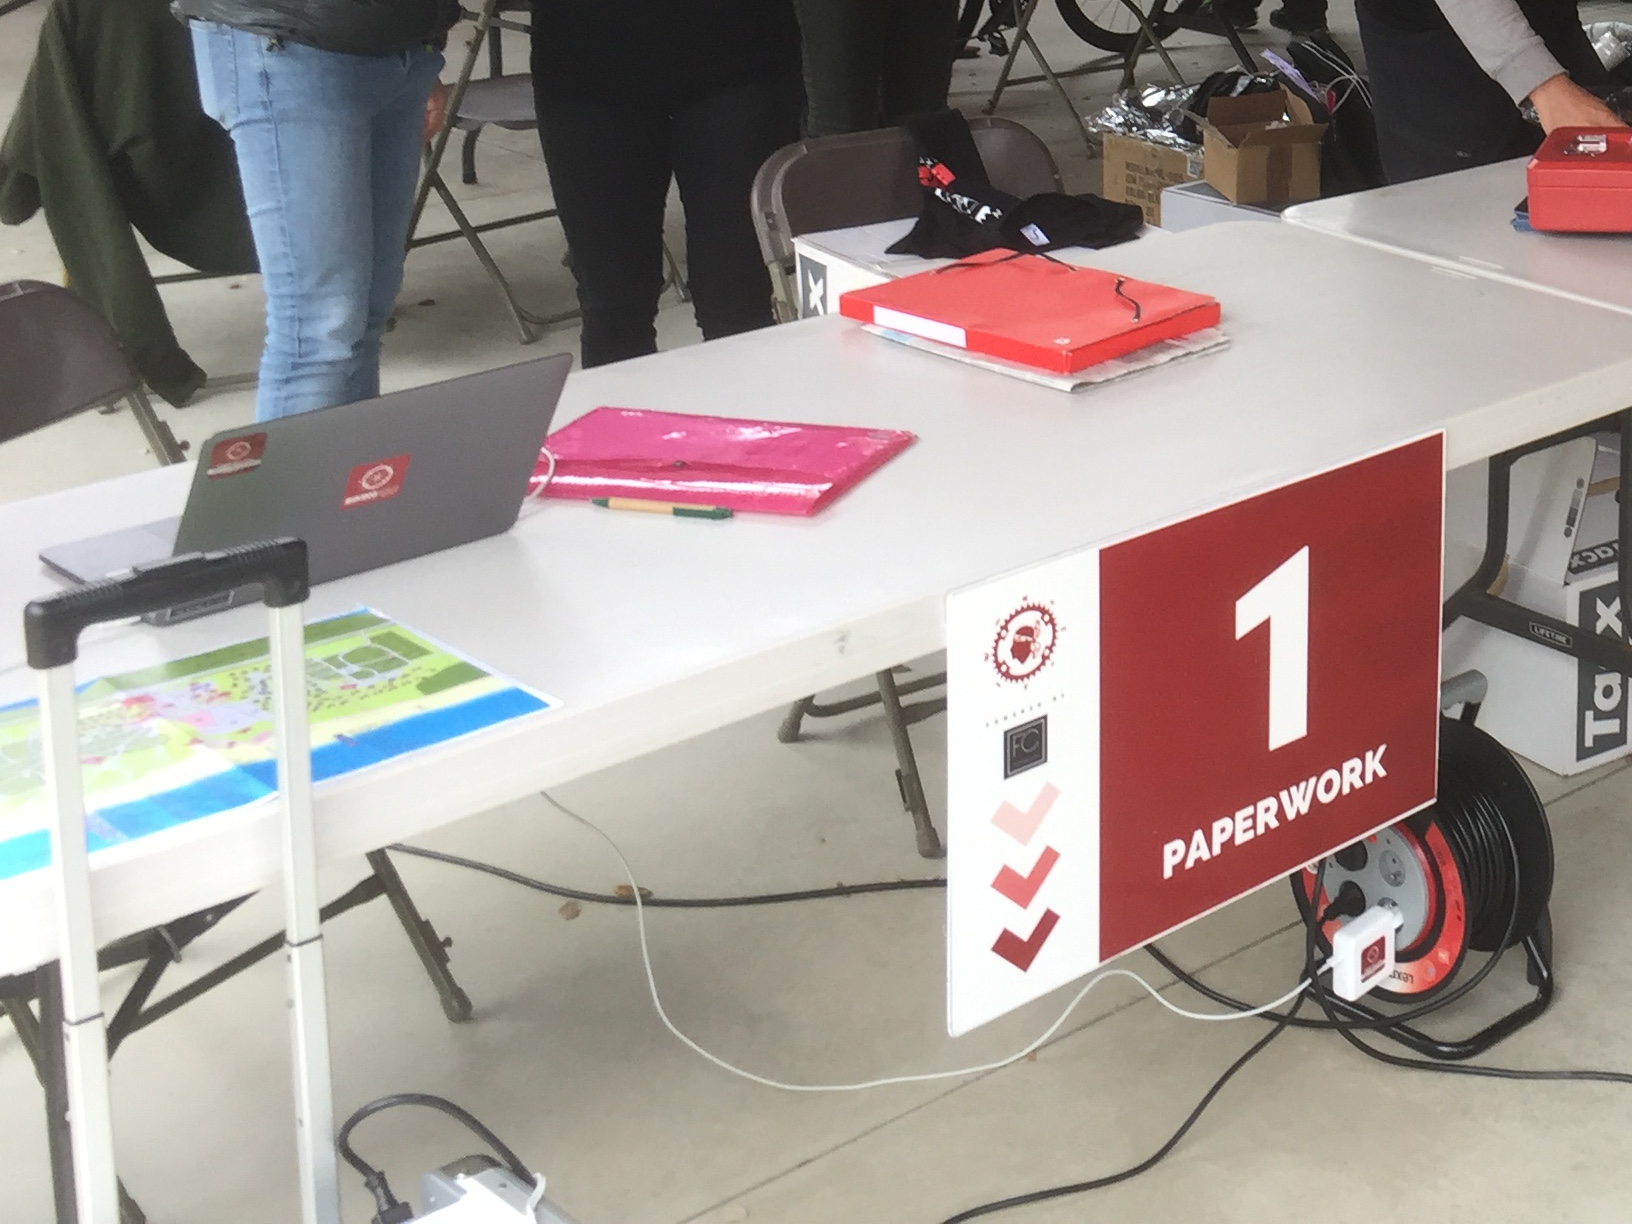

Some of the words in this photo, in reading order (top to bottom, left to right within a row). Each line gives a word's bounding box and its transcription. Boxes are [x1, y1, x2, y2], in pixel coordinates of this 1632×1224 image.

[1571, 542, 1620, 569] acx
[1235, 545, 1309, 752] 1
[1585, 596, 1623, 749] Tax
[1163, 743, 1387, 880] PAPERWORK
